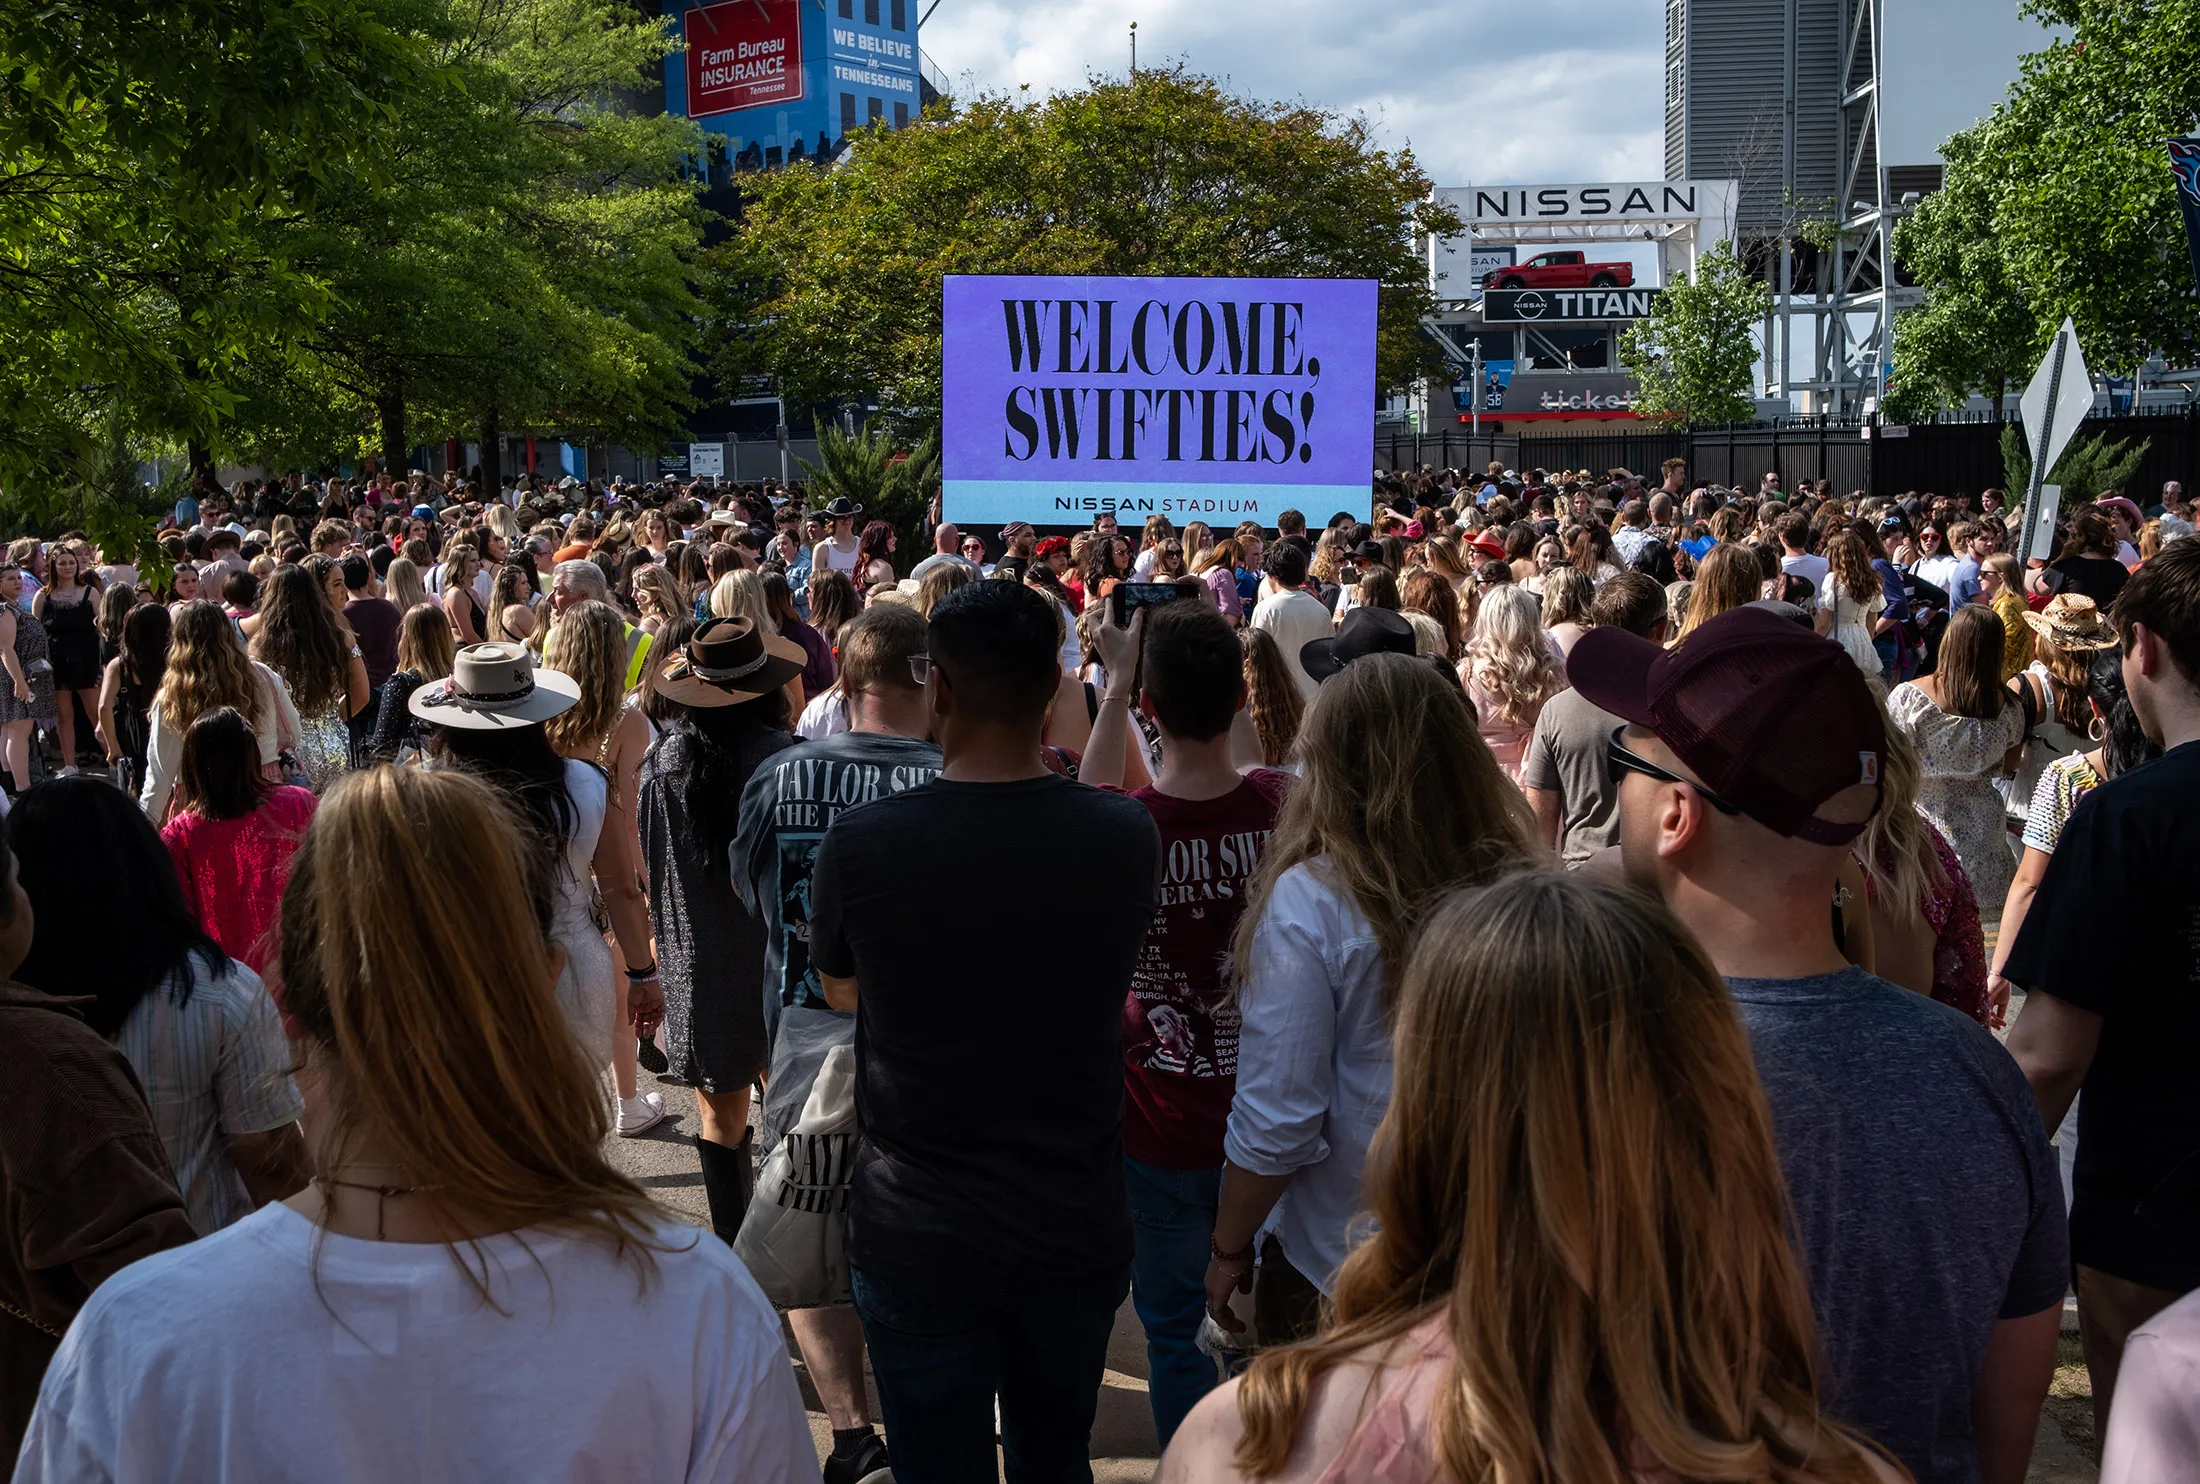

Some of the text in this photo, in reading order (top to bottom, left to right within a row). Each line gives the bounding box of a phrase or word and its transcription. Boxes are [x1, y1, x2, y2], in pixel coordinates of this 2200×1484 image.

[701, 38, 785, 67] Farm Bureau
[833, 28, 912, 60] WE BELIEVE
[867, 53, 880, 69] in
[701, 56, 785, 88] INSURANCE
[834, 65, 913, 93] TENNESSEANS
[750, 83, 785, 96] Tennessee
[1477, 186, 1695, 218] NISSAN
[1471, 257, 1500, 266] SAN
[1555, 292, 1649, 317] TITAN
[1001, 299, 1320, 389] WELCOME,
[1460, 393, 1470, 406] 58
[1487, 394, 1502, 406] 58
[1005, 386, 1312, 465] SWIFTIES!
[1055, 497, 1259, 513] NISSAN STADIUM
[775, 759, 880, 805] TAYLOR
[775, 803, 819, 827] THE
[1160, 880, 1235, 906] ERAS
[1153, 917, 1168, 925] NV
[1148, 945, 1161, 953] TX
[1157, 962, 1170, 970] TN
[1174, 972, 1188, 980] PA
[1219, 1066, 1237, 1076] LOS
